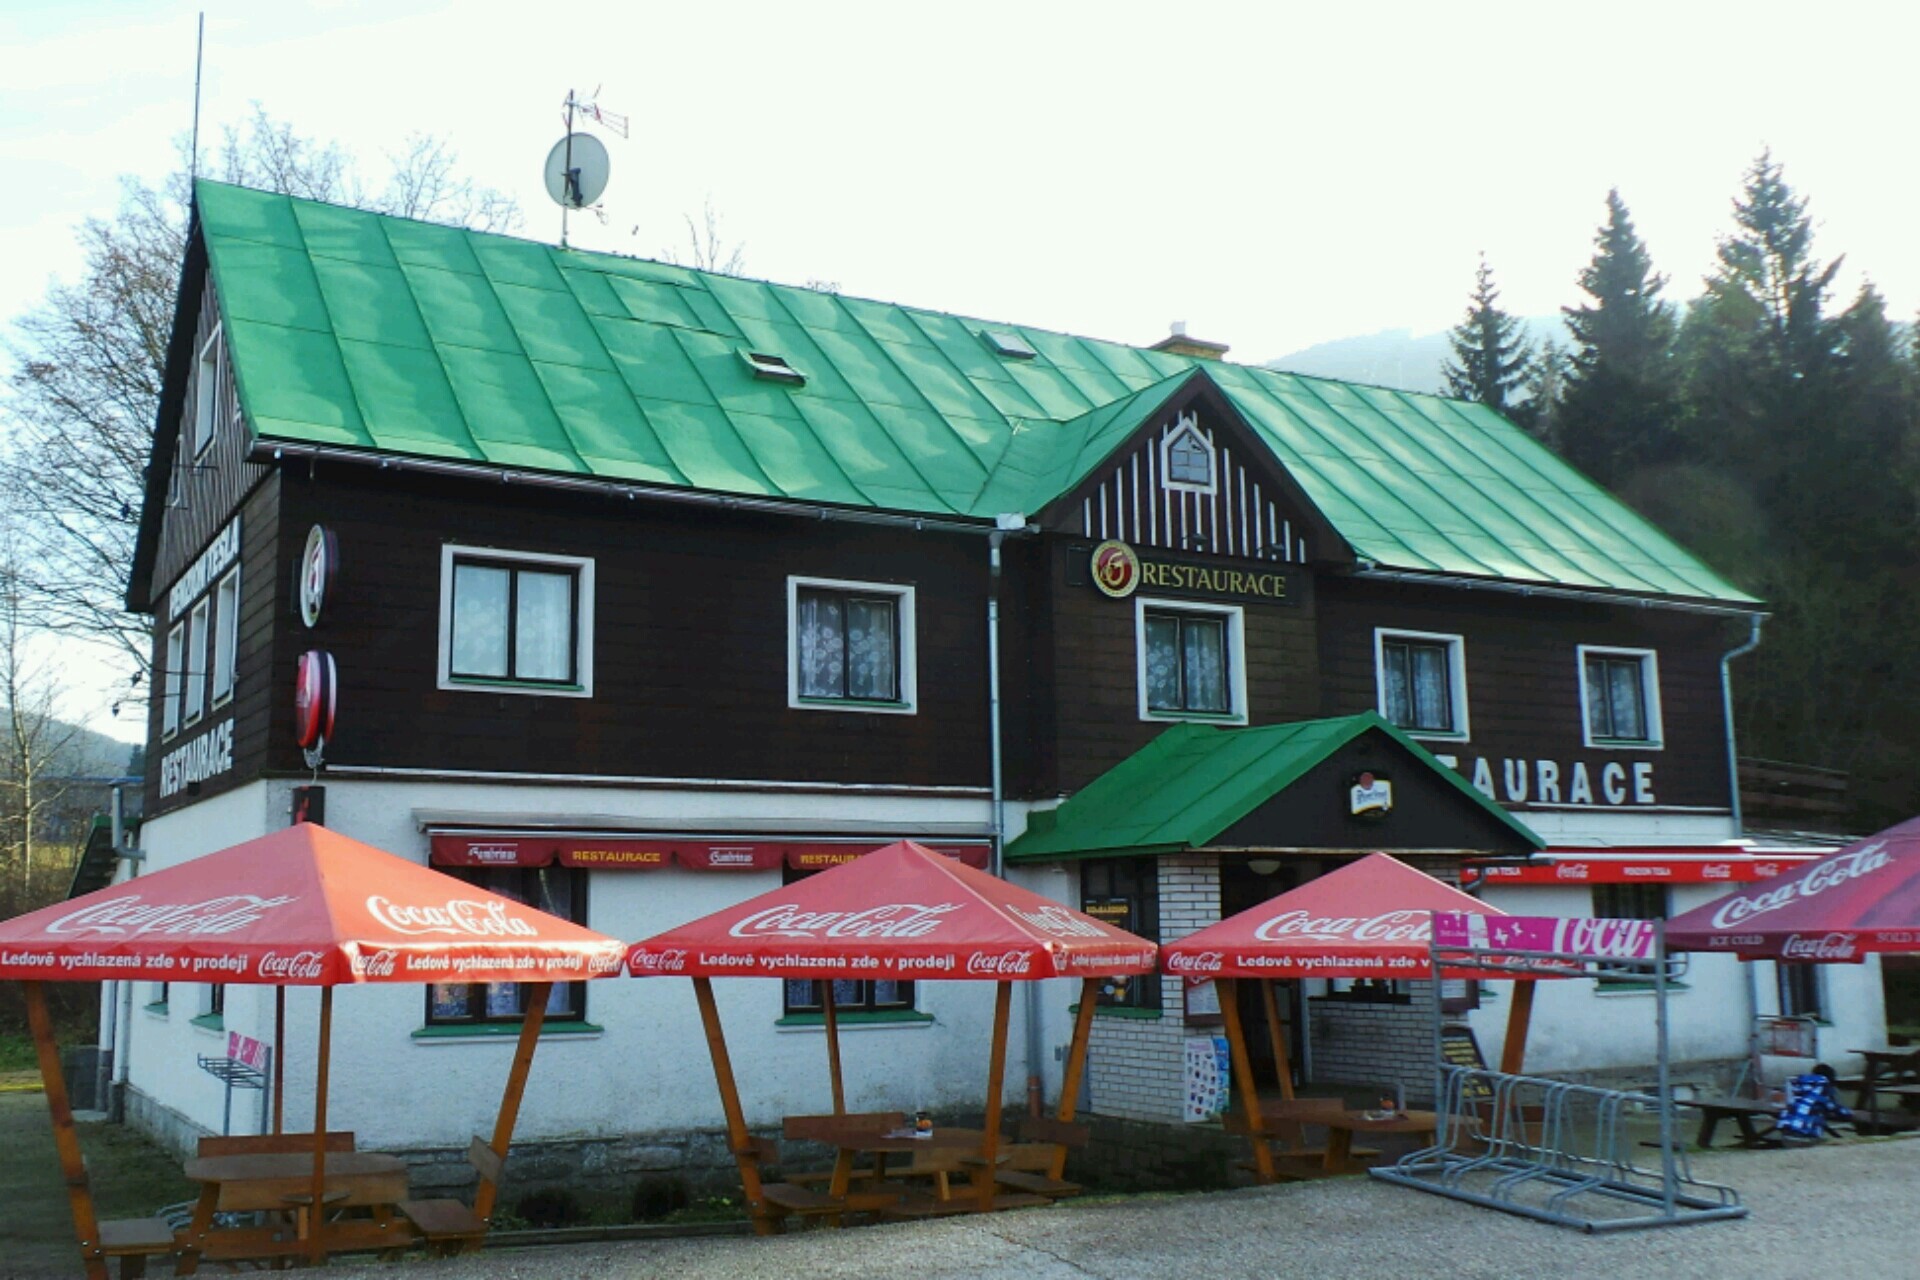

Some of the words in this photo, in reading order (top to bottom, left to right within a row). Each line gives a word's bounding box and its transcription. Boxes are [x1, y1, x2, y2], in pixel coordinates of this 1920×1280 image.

[1141, 562, 1286, 597] RESTAURACE
[160, 717, 234, 798] RESTAURACE
[572, 850, 661, 862] RESTAURACE
[1711, 838, 1896, 929] Coca-Cola
[45, 894, 300, 934] Coca-Cola
[366, 895, 538, 936] Coca-Cola
[728, 903, 967, 937] Coca-Cola
[1254, 910, 1431, 941] Coca-Col
[1731, 935, 1764, 946] COLD
[1783, 932, 1858, 959] Coca-Cola
[1876, 932, 1912, 943] SOLD
[1, 950, 54, 966] Ledově
[59, 951, 141, 971] vychlazená
[146, 952, 174, 968] zde
[179, 954, 189, 968] v
[193, 954, 248, 972] prodeji
[258, 951, 325, 978] Coca-Cola
[515, 956, 536, 969] zde
[538, 957, 545, 969] v
[546, 956, 583, 971] prodeji
[630, 948, 687, 971] Coca-Cola
[700, 952, 754, 967] Ledově
[759, 953, 846, 969] vychlazená
[851, 954, 879, 968] zde
[884, 957, 894, 968] v
[898, 954, 955, 971] prodeji
[967, 950, 1033, 974] Coca-Cola
[1167, 951, 1225, 971] Coca-Cola
[1237, 954, 1292, 967] Ledově
[1296, 954, 1383, 970] vychlazená
[1388, 954, 1416, 968] zde
[1420, 957, 1431, 968] v
